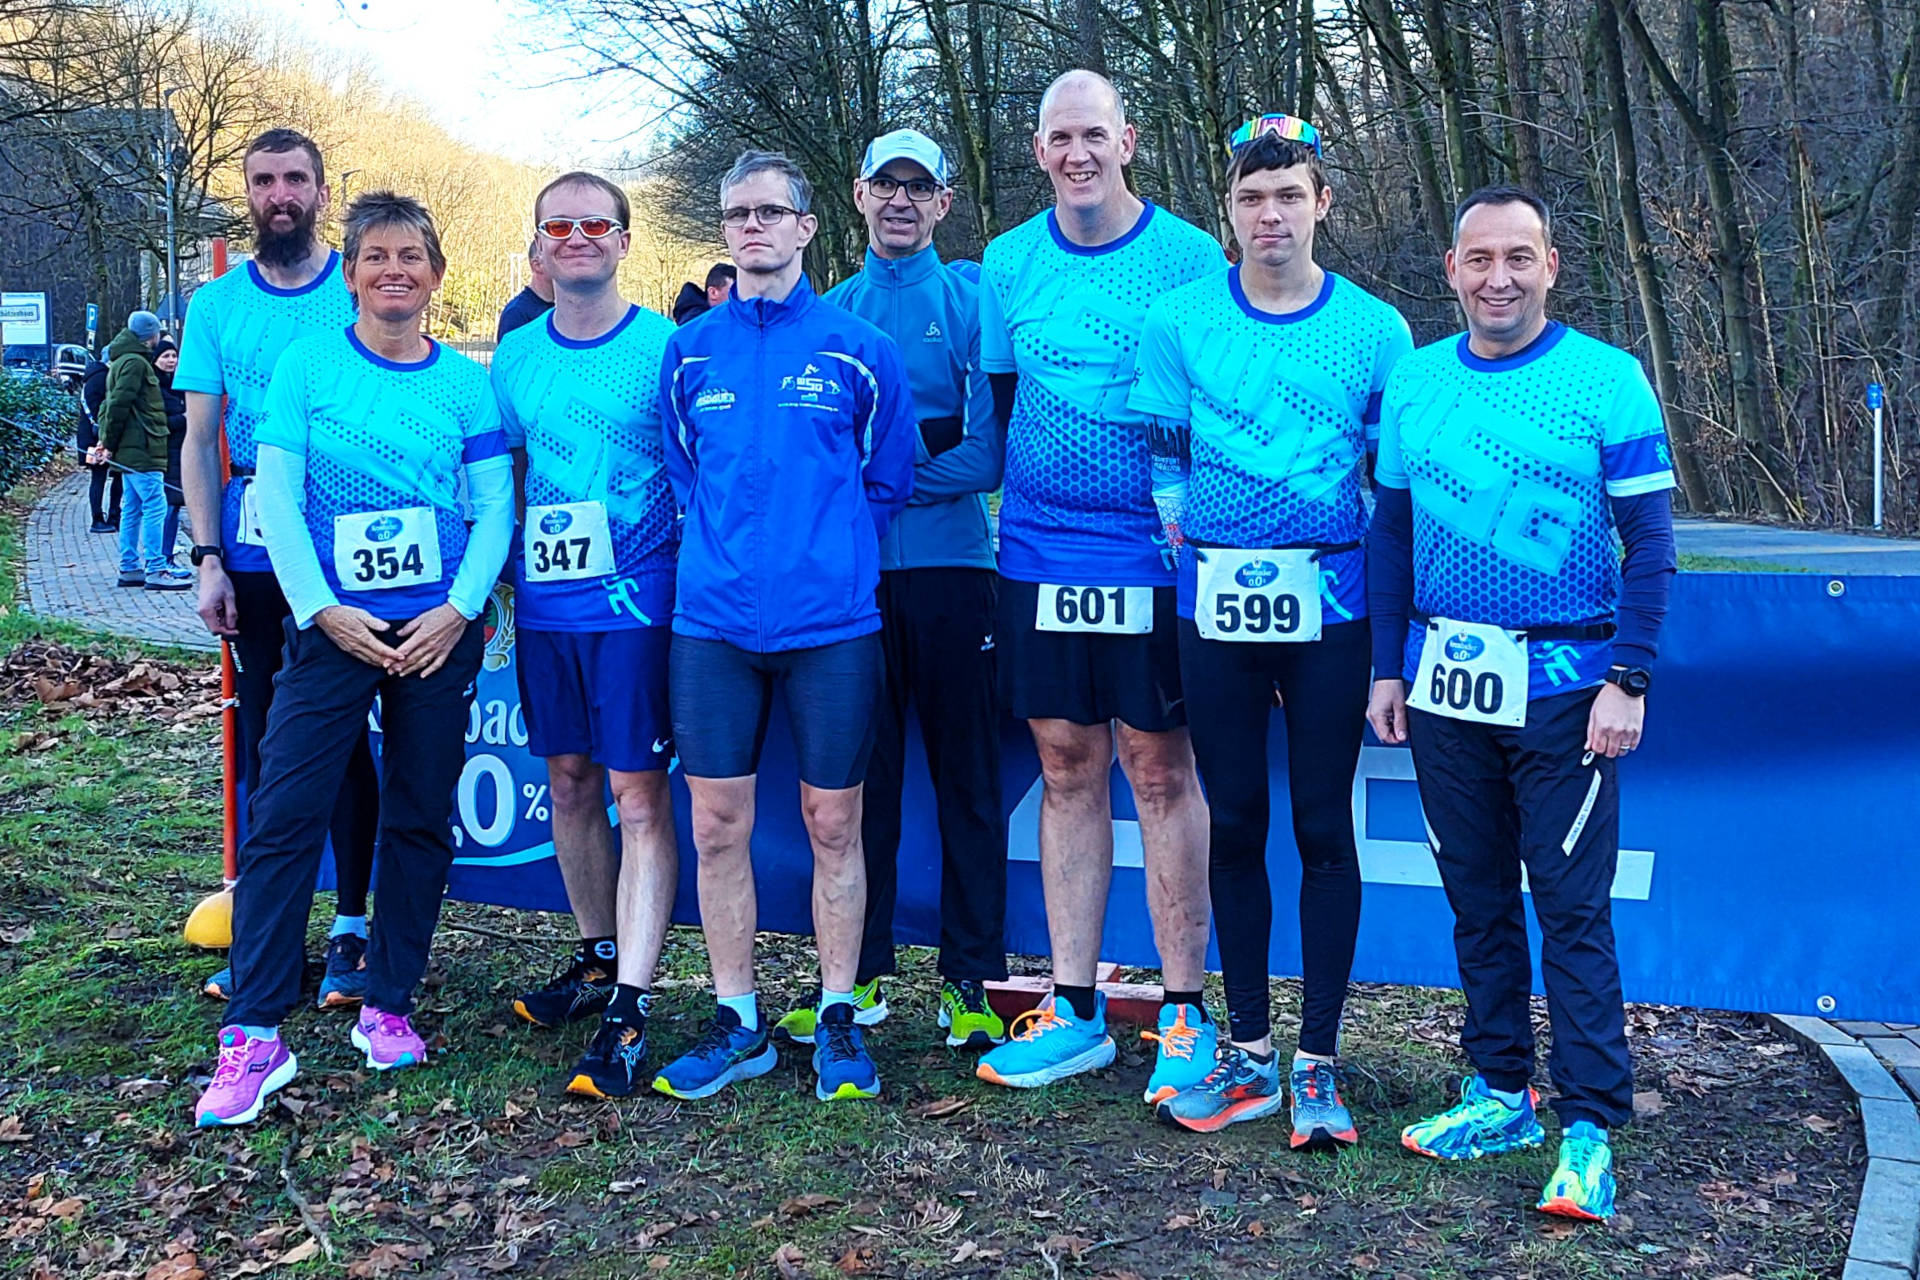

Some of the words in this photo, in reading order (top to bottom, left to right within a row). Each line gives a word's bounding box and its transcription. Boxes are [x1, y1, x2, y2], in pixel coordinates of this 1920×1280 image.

[353, 543, 424, 582] 354
[533, 537, 591, 573] 347
[1056, 586, 1125, 625] 601
[1216, 593, 1300, 634] 599
[1430, 663, 1503, 715] 600
